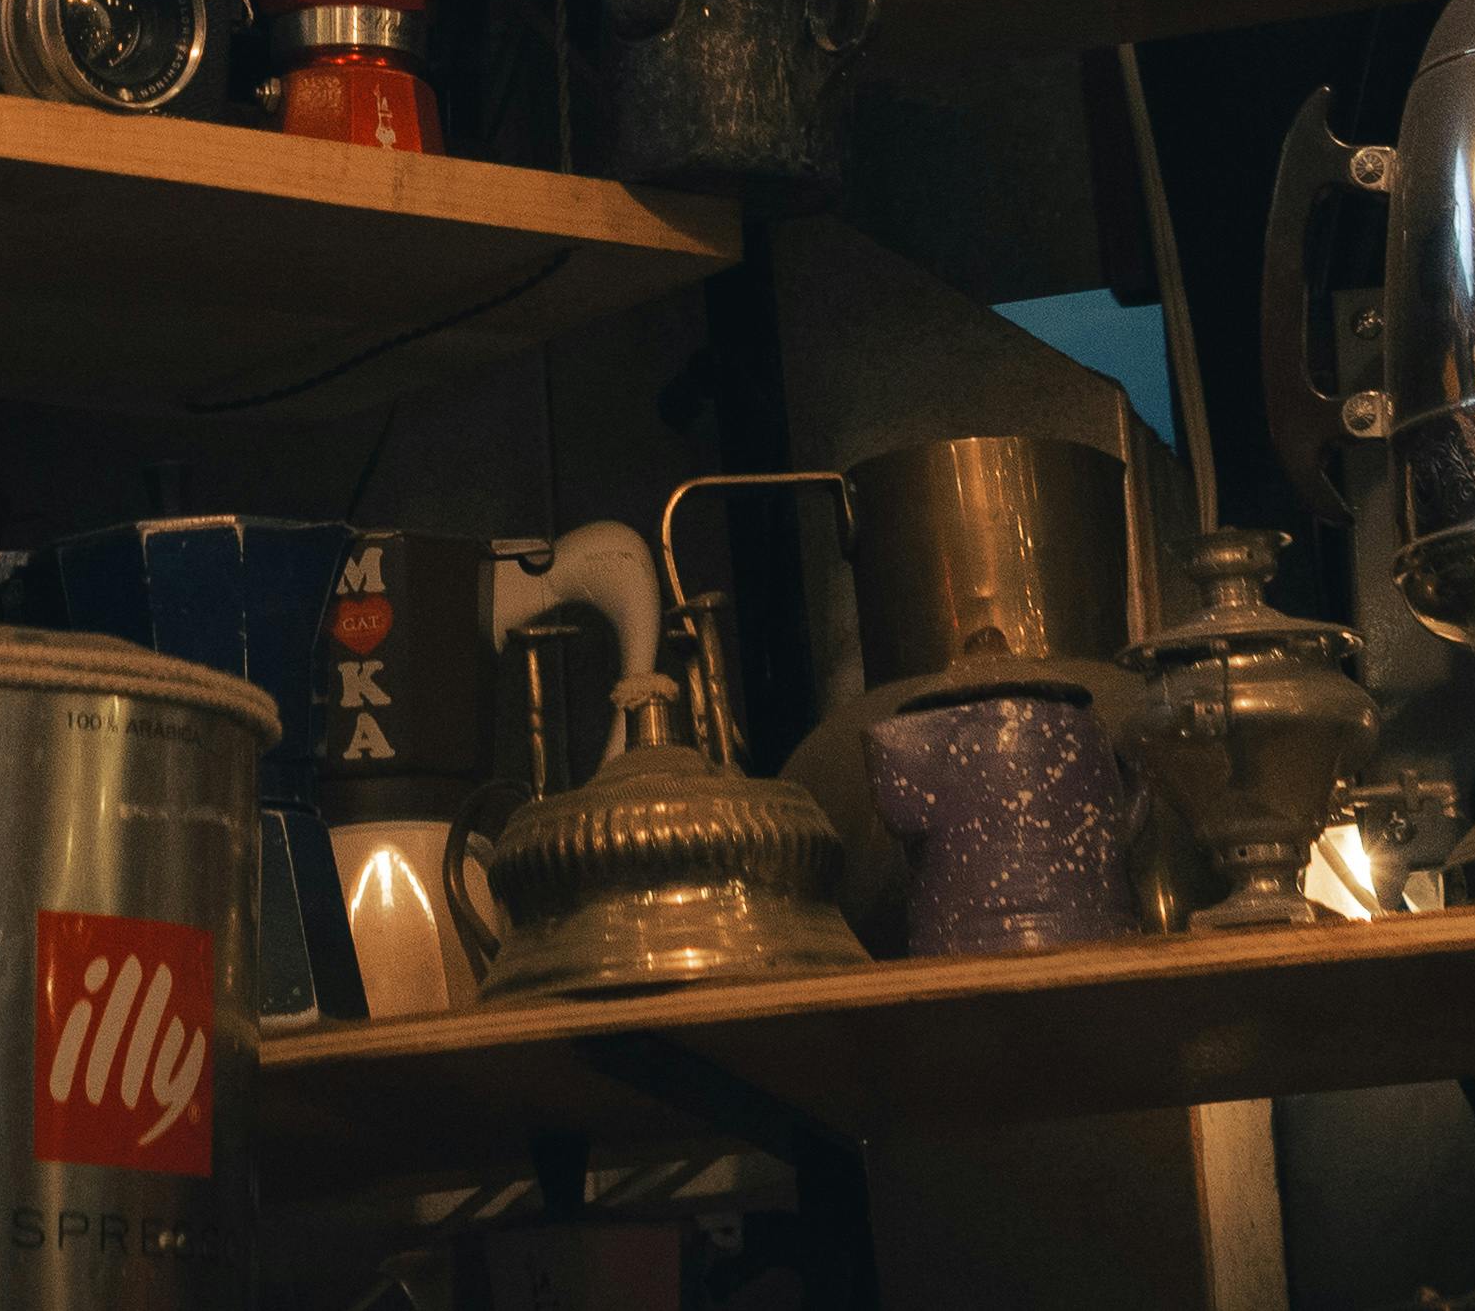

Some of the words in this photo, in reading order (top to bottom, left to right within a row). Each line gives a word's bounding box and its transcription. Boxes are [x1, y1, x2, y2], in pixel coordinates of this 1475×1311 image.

[342, 615, 380, 631] CAT
[67, 711, 103, 730] 100
[49, 953, 207, 1147] illy
